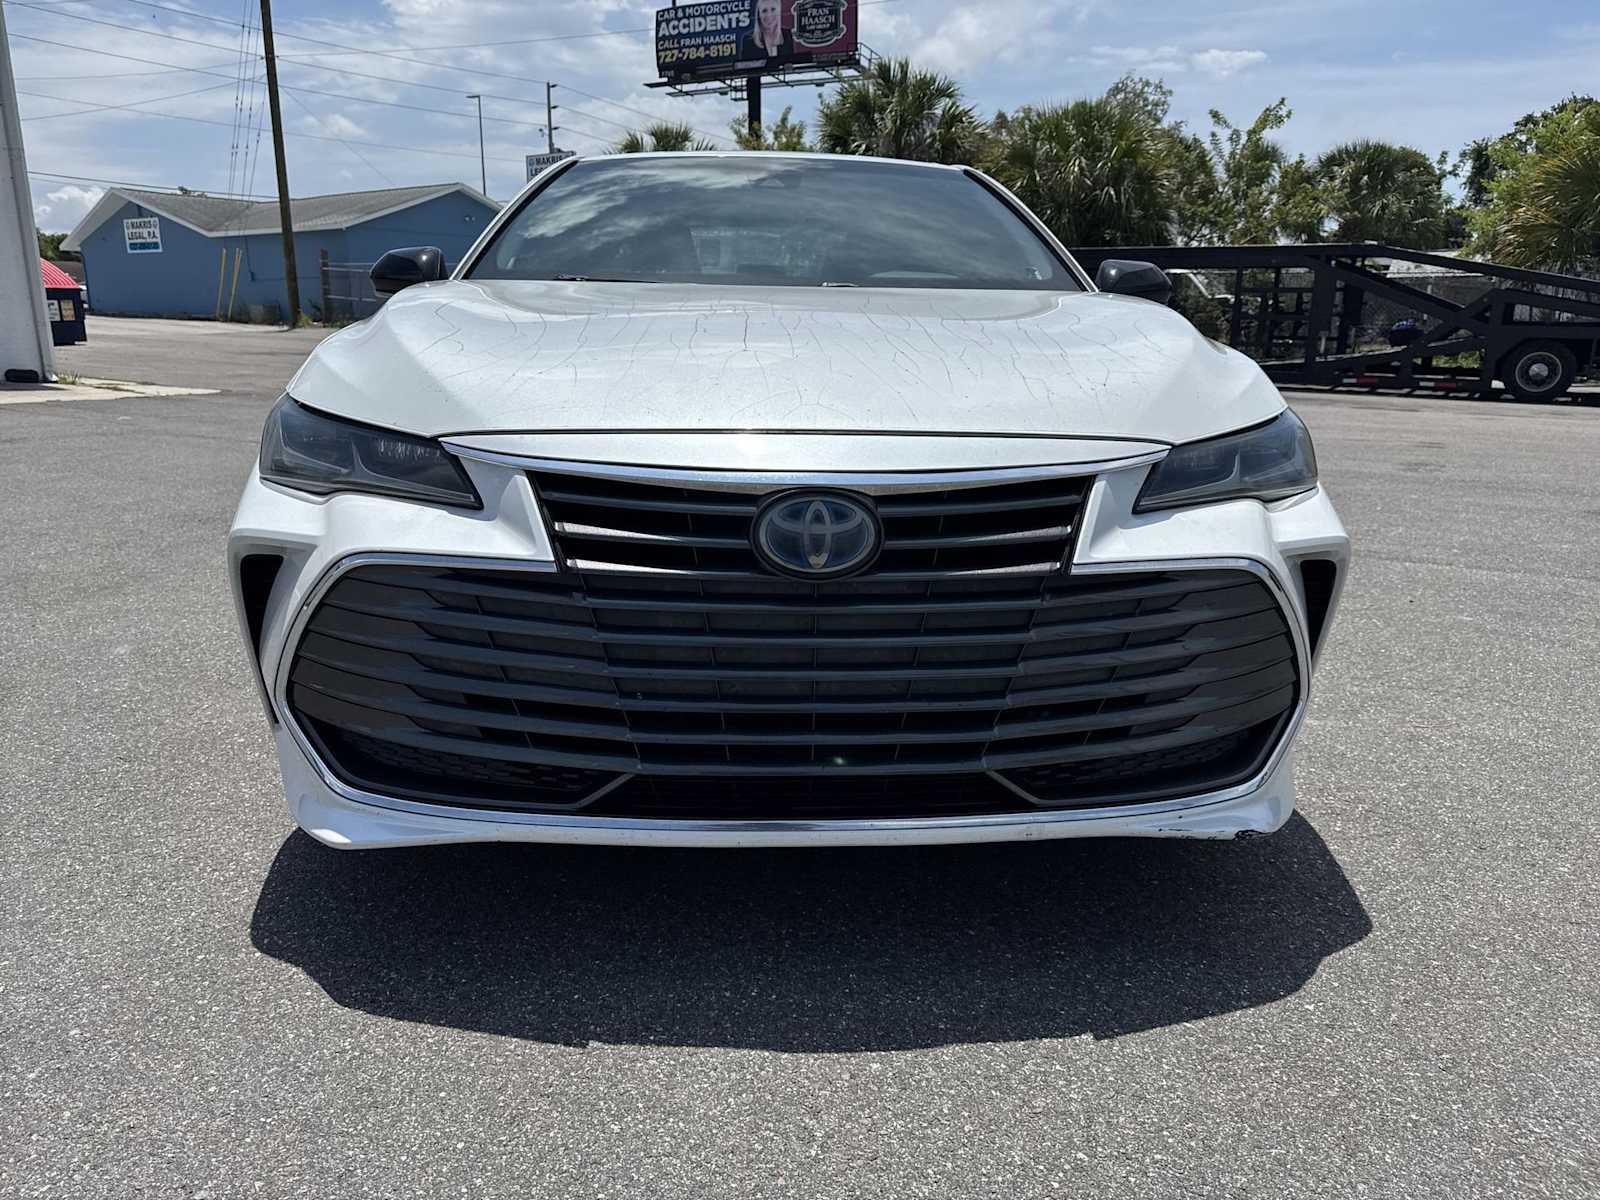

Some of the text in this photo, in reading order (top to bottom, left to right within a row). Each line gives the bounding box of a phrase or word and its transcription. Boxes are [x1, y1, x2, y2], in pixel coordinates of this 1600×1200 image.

[658, 0, 751, 20] CAR & MOTORCYCLE
[808, 7, 830, 17] FRAN
[658, 11, 751, 37] ACCIDENTS
[801, 14, 835, 25] HAASCH
[657, 33, 737, 50] CALL FRAN HAASCH
[657, 43, 737, 65] 727-784-8191
[535, 155, 562, 165] MAKRIS
